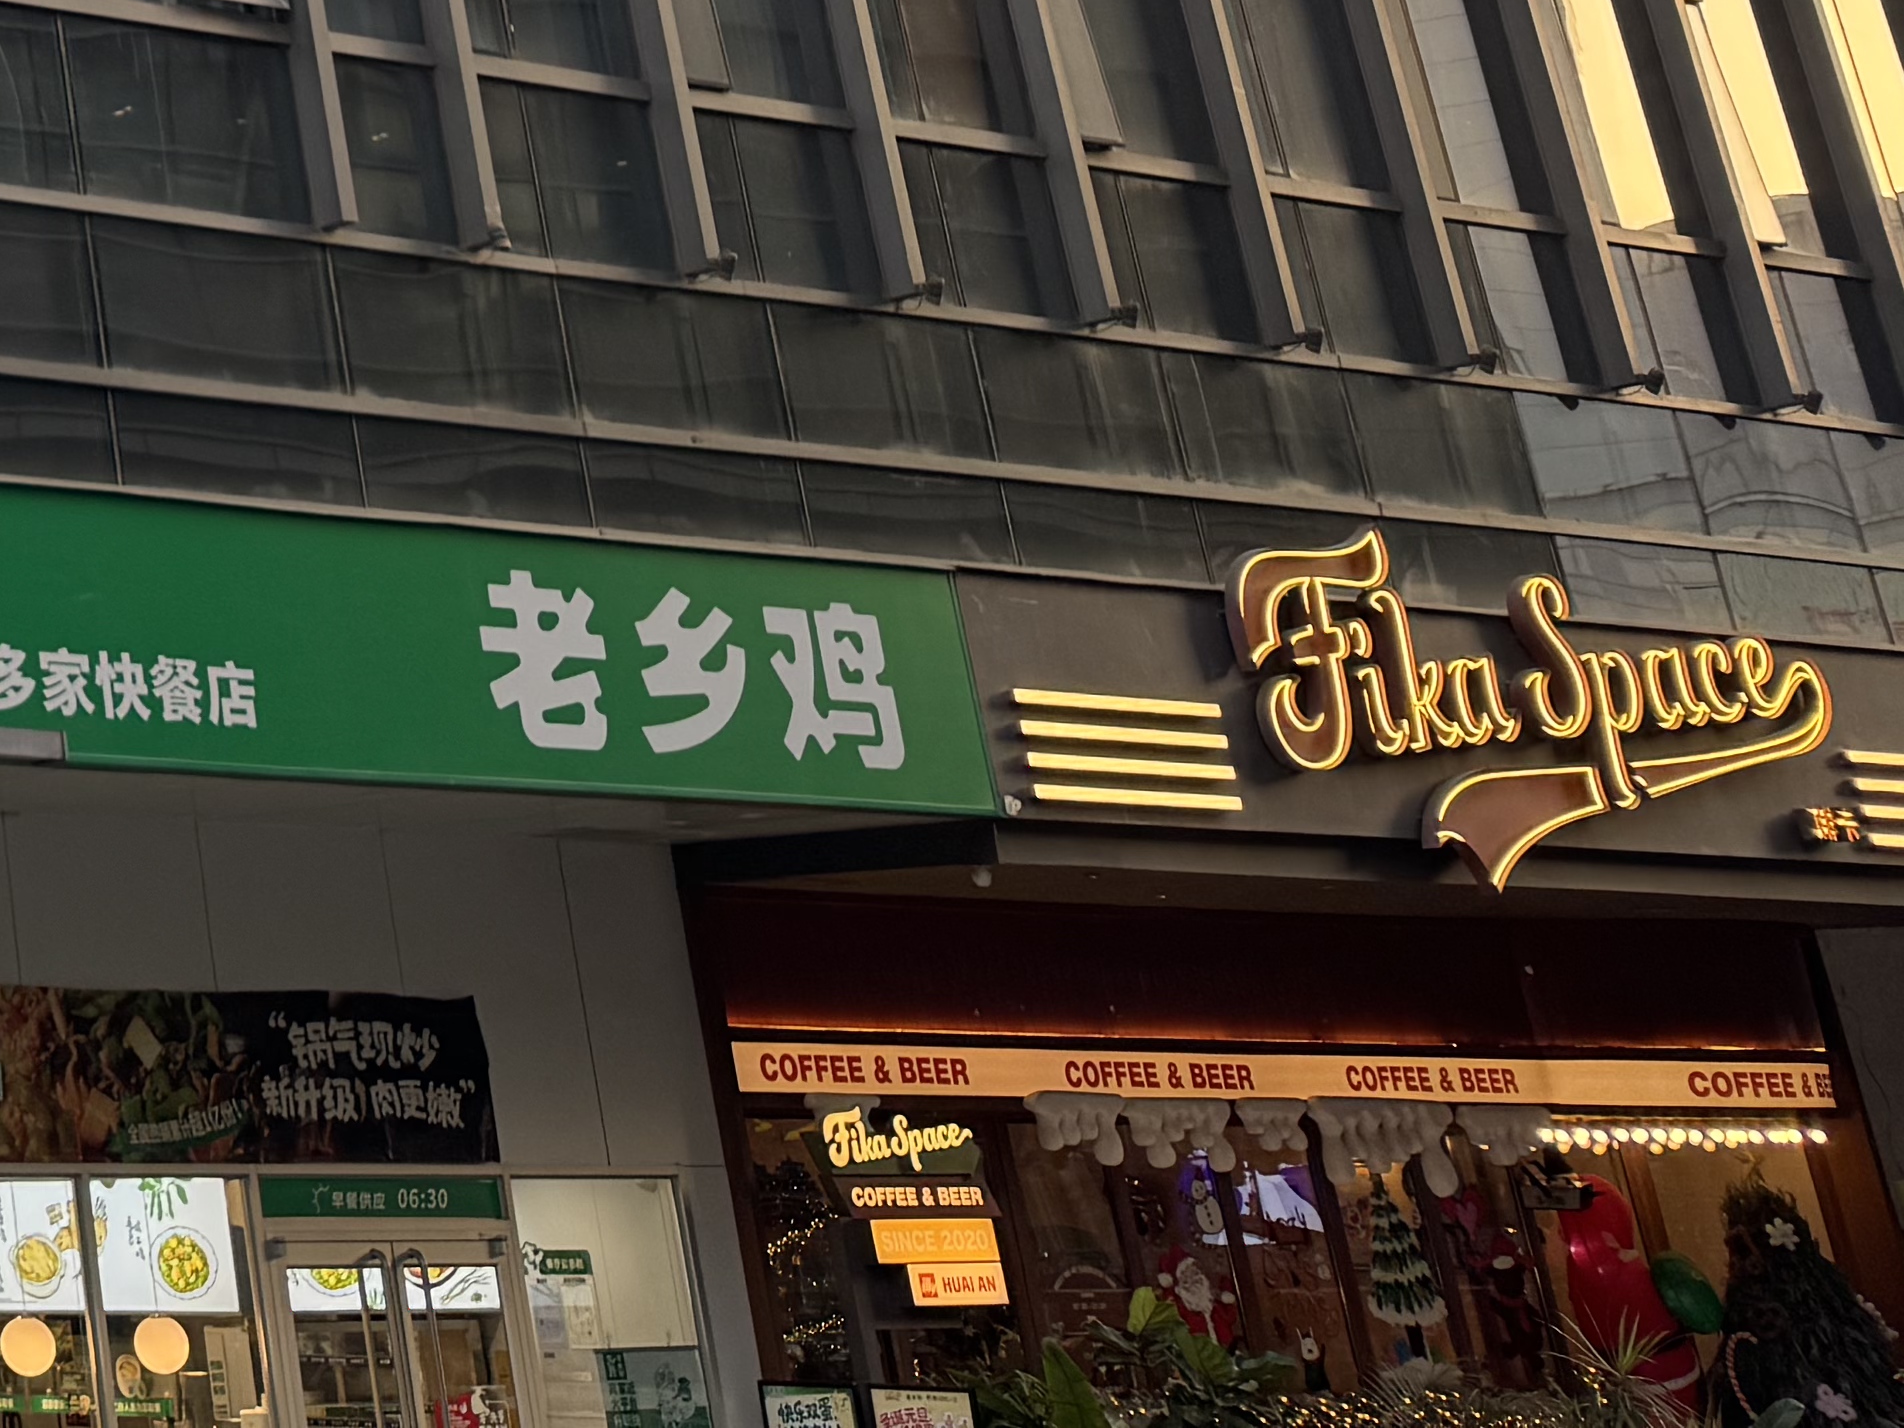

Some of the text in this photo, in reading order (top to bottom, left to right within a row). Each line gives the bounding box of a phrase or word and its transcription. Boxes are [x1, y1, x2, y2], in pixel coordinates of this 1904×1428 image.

[479, 568, 905, 771] 老乡鸡
[1225, 524, 1832, 809] Fika Space
[760, 1054, 970, 1086] COFFEE & BEER
[1064, 1060, 1255, 1091] COFFEE & BEER
[1346, 1065, 1519, 1095] COFFEE & BEER
[1687, 1070, 1797, 1098] COFFEE
[1801, 1072, 1814, 1097] &
[823, 1105, 973, 1172] Fika Space
[397, 1187, 448, 1210] 06:30
[851, 1187, 984, 1207] COFFEE & BEER
[879, 1228, 989, 1253] SINCE 2020
[941, 1275, 975, 1293] HUAI
[978, 1275, 997, 1293] AN
